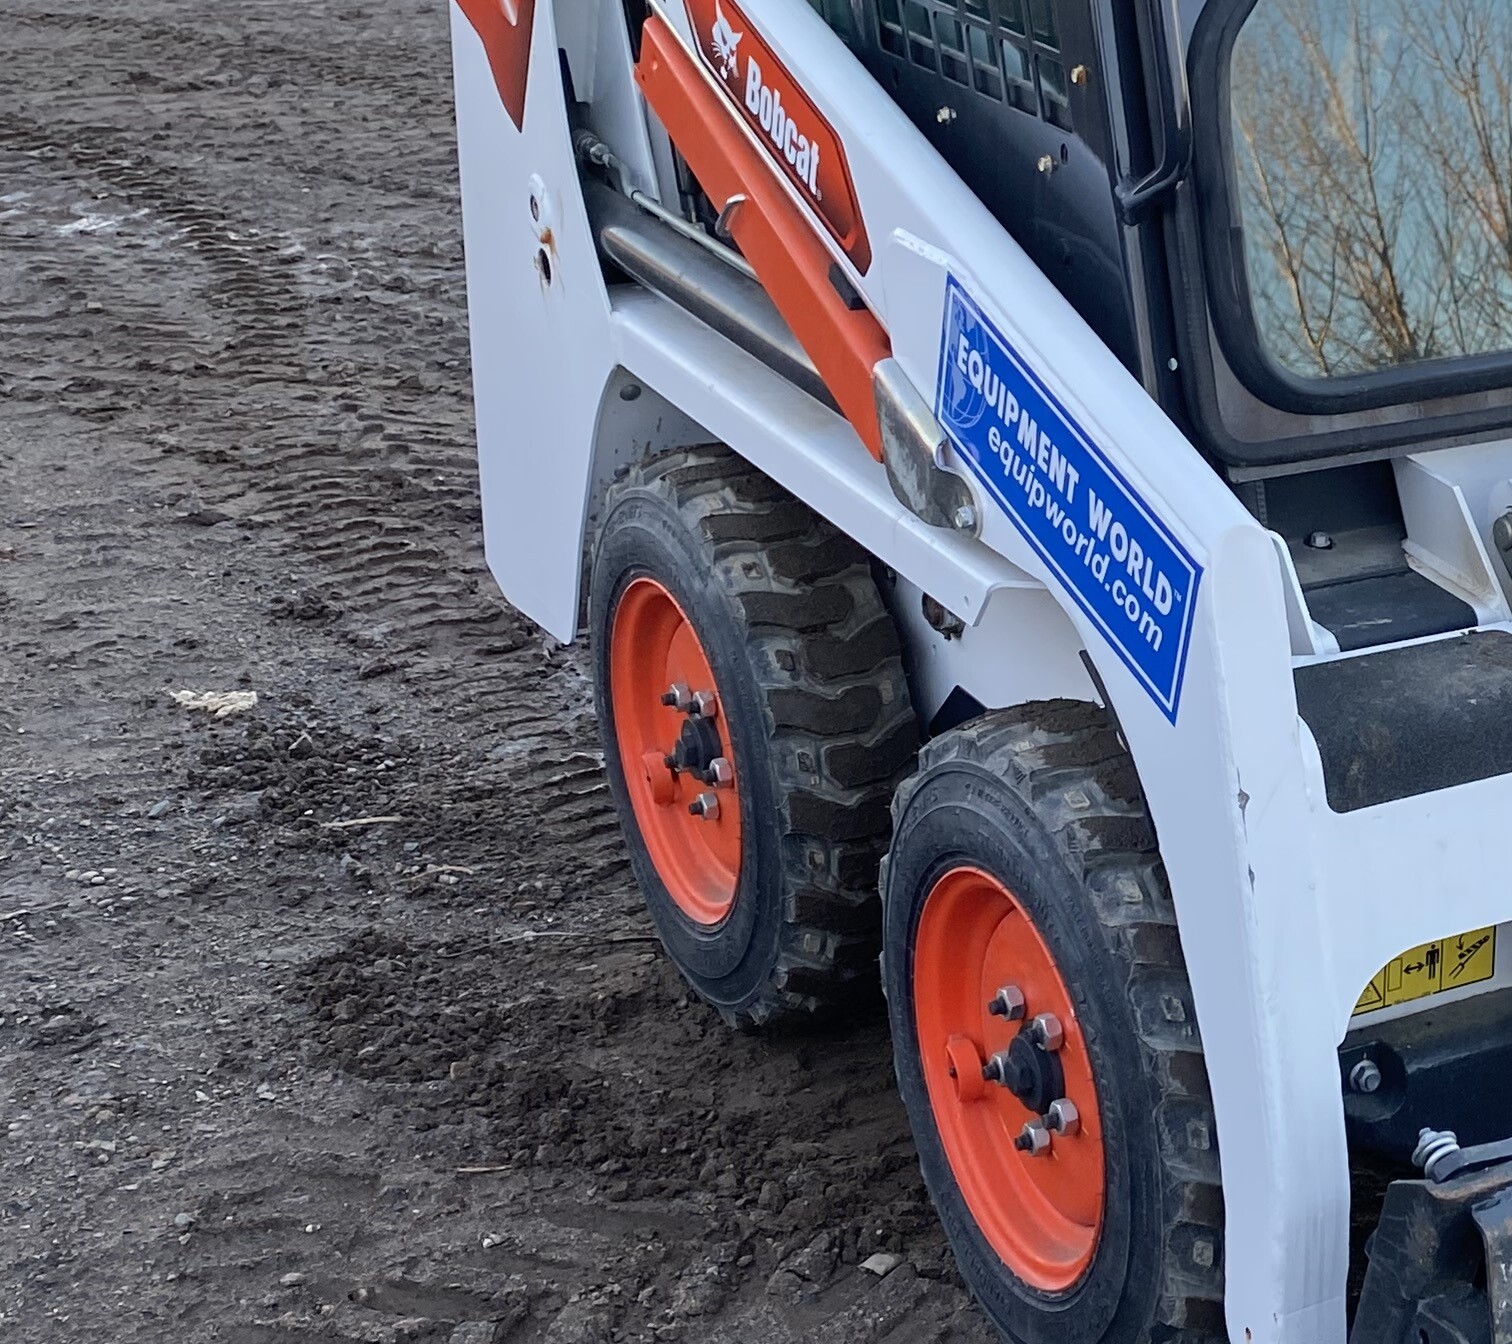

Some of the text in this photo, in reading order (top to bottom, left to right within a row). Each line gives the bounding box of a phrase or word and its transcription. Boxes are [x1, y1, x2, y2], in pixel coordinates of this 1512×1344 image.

[745, 55, 820, 196] Bobcat
[957, 332, 1080, 504] EQUIPMENT
[1088, 487, 1173, 616] WORLD
[988, 426, 1163, 653] equipworld.com
